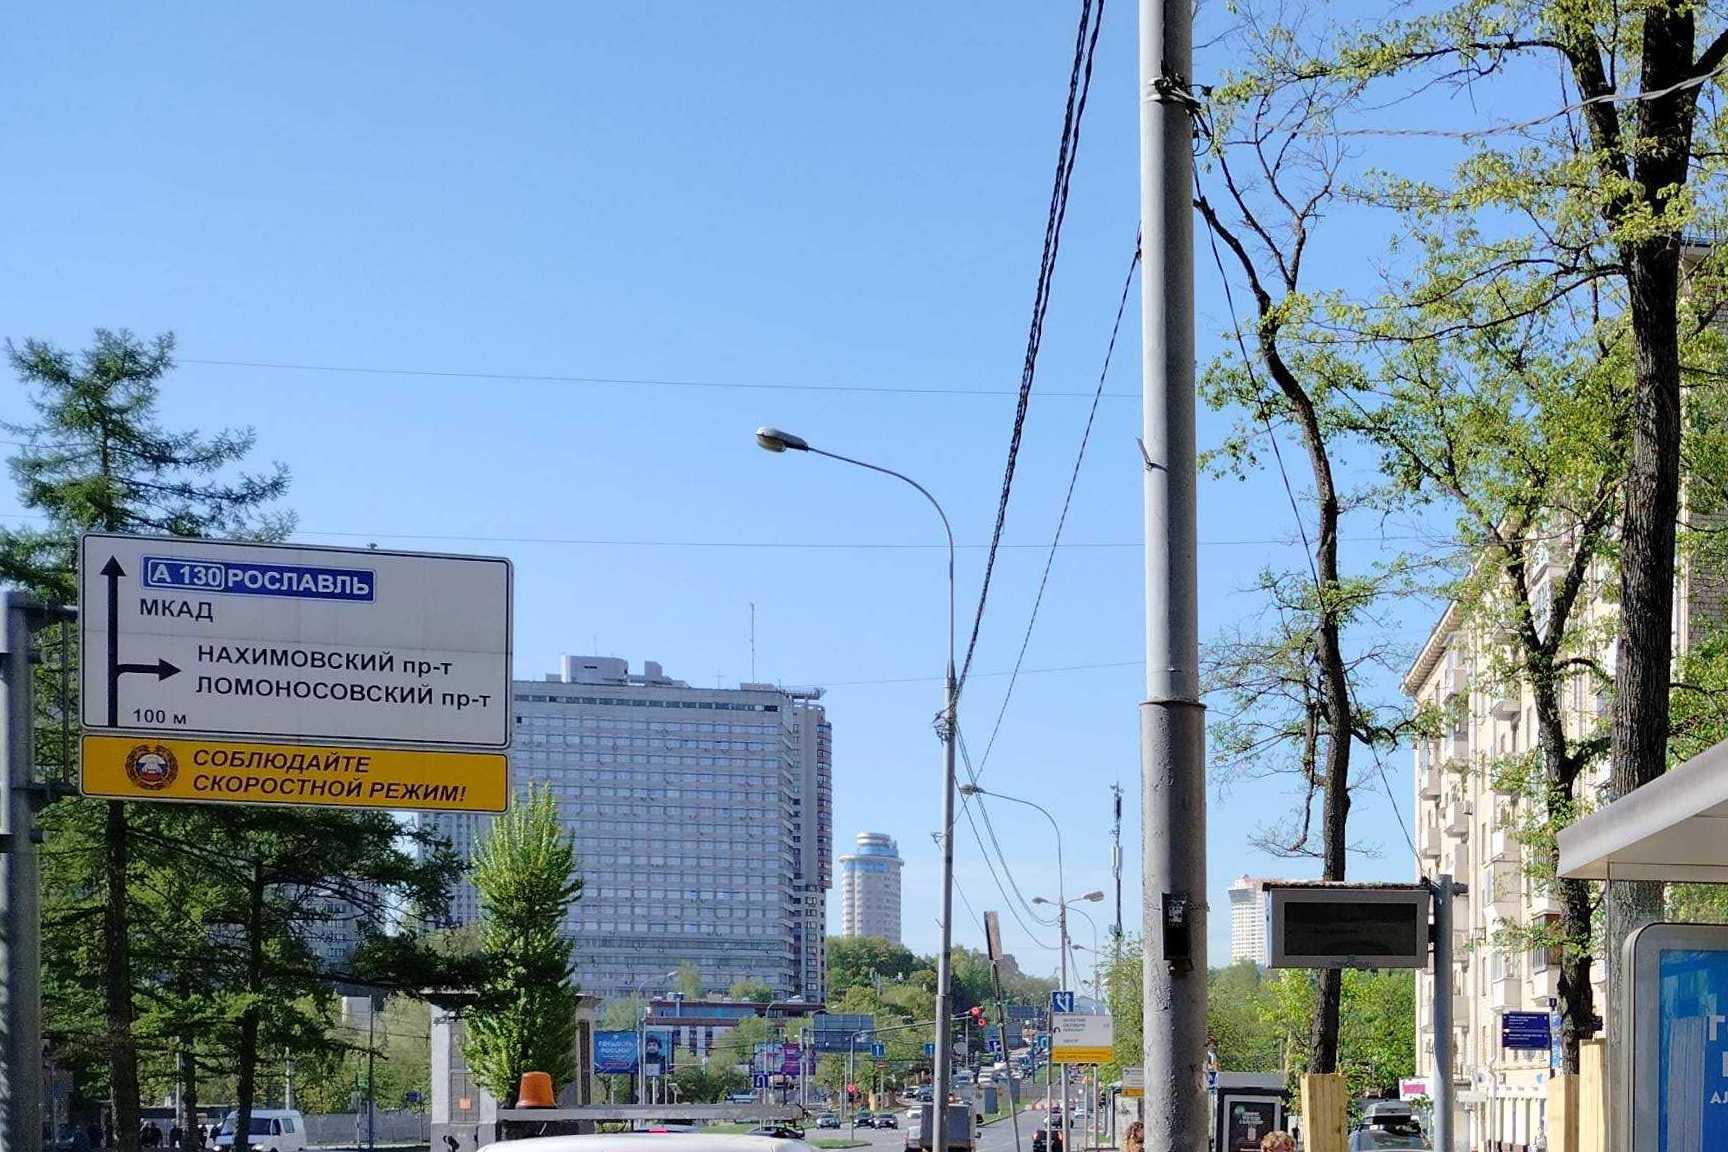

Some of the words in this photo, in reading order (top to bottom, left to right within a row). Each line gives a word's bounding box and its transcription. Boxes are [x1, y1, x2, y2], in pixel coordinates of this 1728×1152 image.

[180, 565, 222, 587] 130
[227, 569, 369, 595] РОСЛАВЛЬ
[139, 598, 214, 622] МКАД
[198, 645, 394, 672] НАХИМОВСКИЙ
[402, 659, 453, 676] пр-т
[196, 676, 433, 705] ЛОМОНОСОВСКИЙ
[441, 691, 491, 710] пр-т
[132, 709, 166, 724] 100
[172, 714, 187, 725] м
[192, 749, 371, 773] СОБЛЮДАЙТЕ
[192, 774, 362, 799] СКОРОСТНОЙ
[368, 781, 467, 802] РЕЖИМ!
